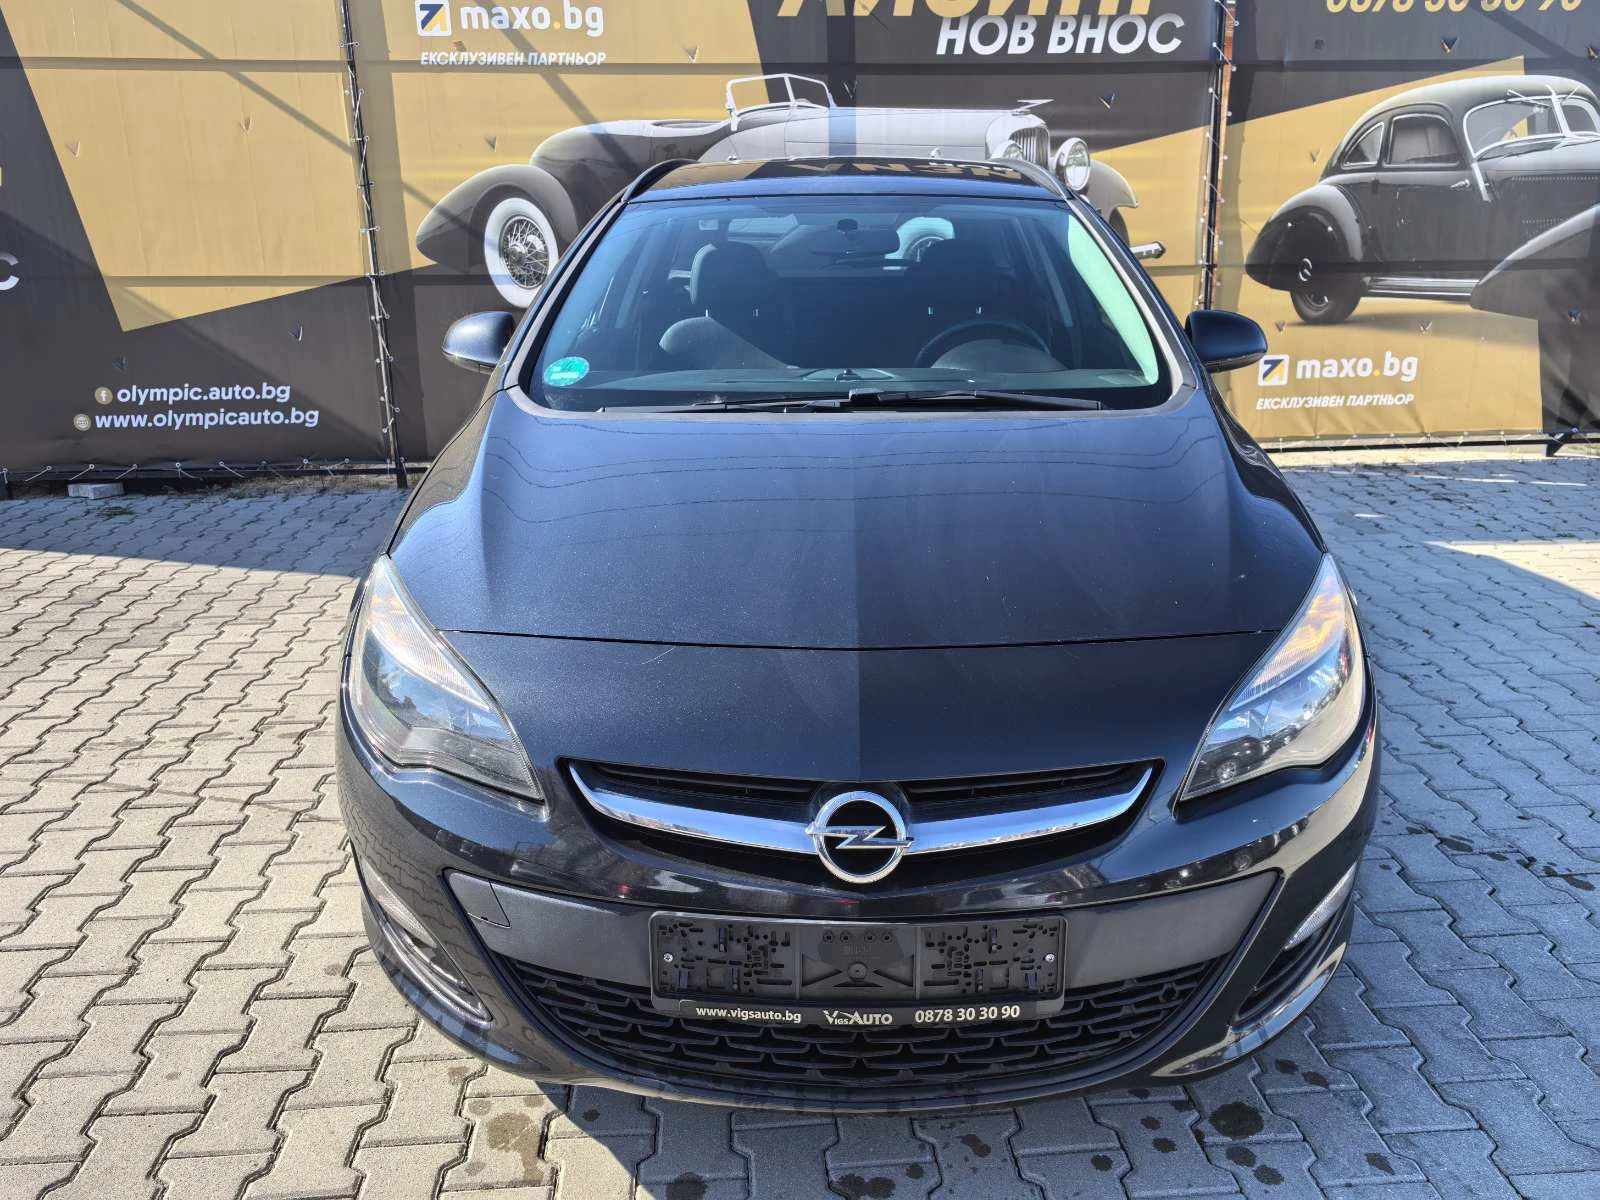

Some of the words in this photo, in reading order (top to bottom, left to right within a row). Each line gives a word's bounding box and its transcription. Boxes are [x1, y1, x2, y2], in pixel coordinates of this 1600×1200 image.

[459, 0, 604, 37] maxo.bg
[936, 14, 1037, 55] НОВ
[1047, 13, 1185, 54] ВНОС
[420, 51, 524, 65] ЕКСКЛУЗИВЕН
[527, 51, 606, 65] ПАРТНЬОР
[1295, 351, 1418, 382] maxo.bg
[116, 382, 291, 404] olympic.auto.bg
[1255, 397, 1345, 410] ЕКСКЛУЗИВЕН
[1346, 393, 1415, 407] ПАРТНЬОР
[94, 407, 320, 429] www.olympicauto.bg
[695, 1006, 802, 1023] www.vigsauto.bg
[914, 1009, 953, 1023] 0878
[956, 1007, 976, 1021] 30
[978, 1006, 998, 1019] 30
[1001, 1005, 1020, 1018] 90
